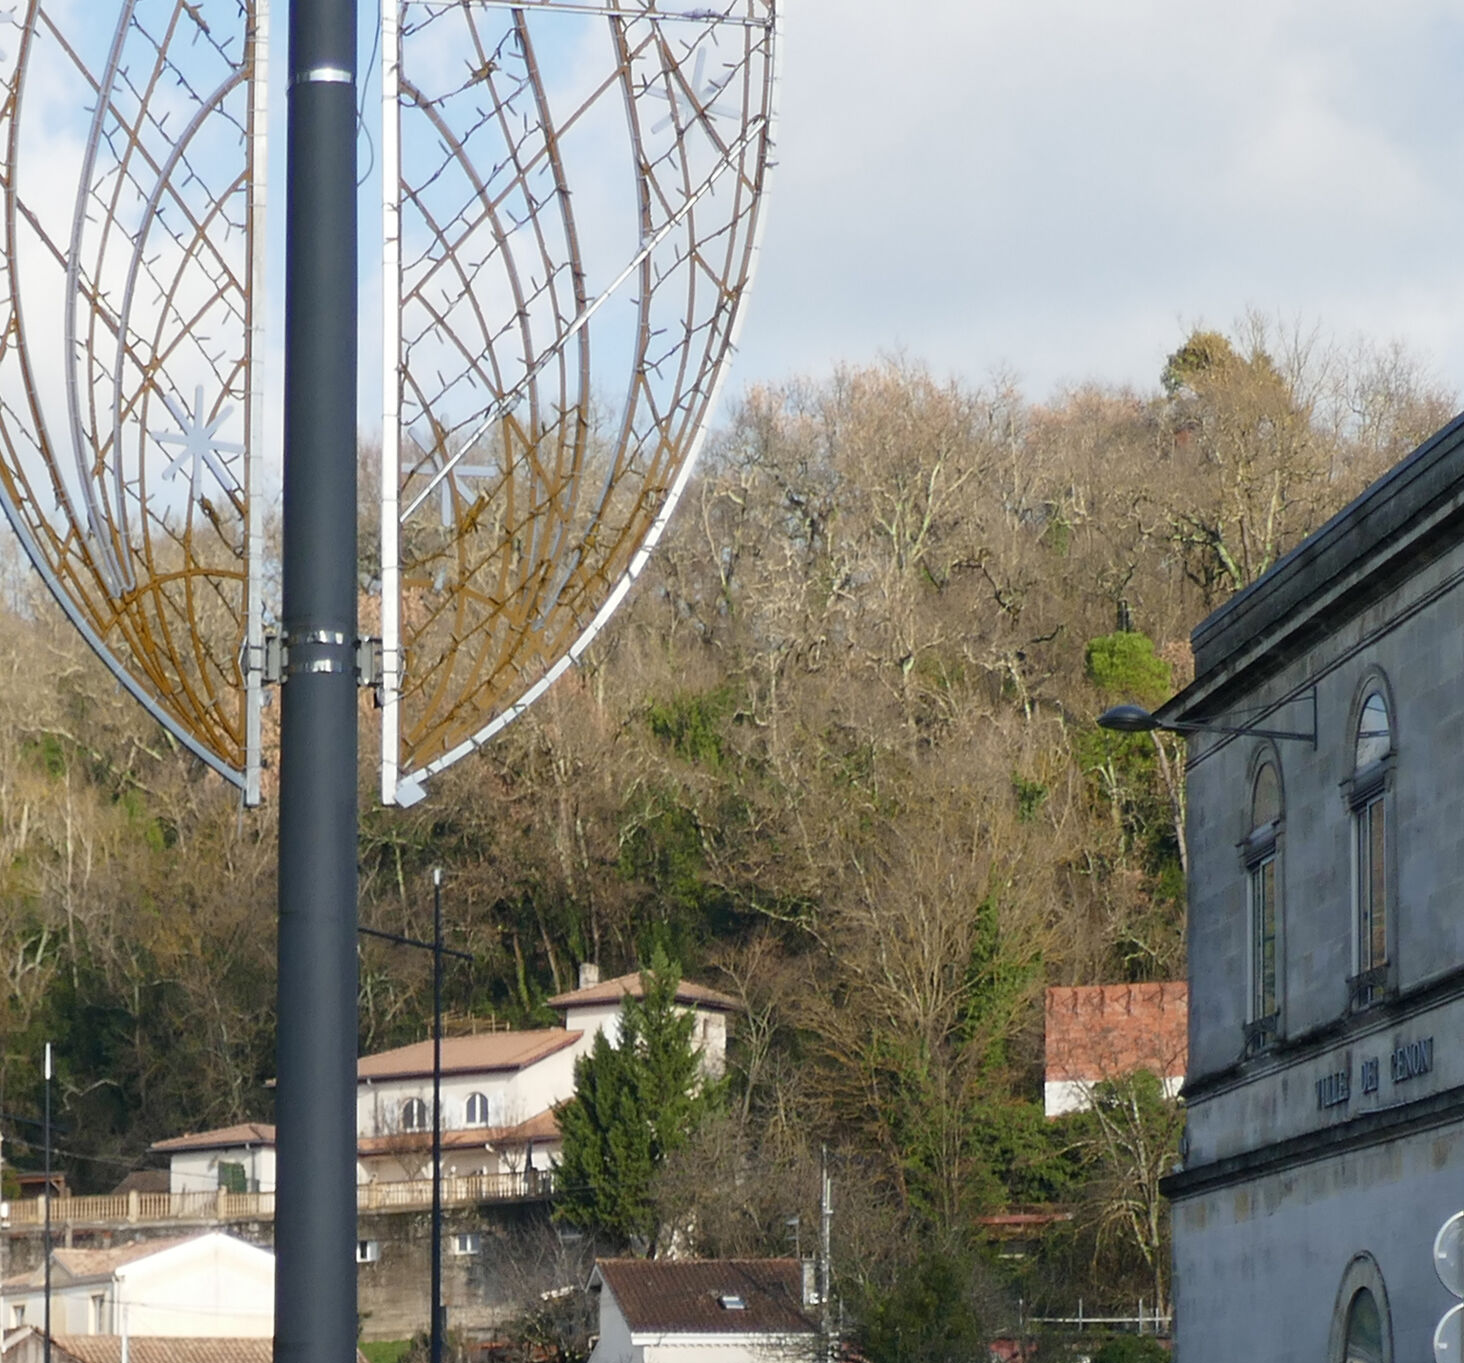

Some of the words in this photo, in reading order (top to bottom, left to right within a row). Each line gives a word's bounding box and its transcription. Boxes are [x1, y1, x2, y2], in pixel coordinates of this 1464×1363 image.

[1315, 1068, 1351, 1110] VILLE
[1361, 1056, 1379, 1095] DE
[1391, 1036, 1434, 1084] CENON
